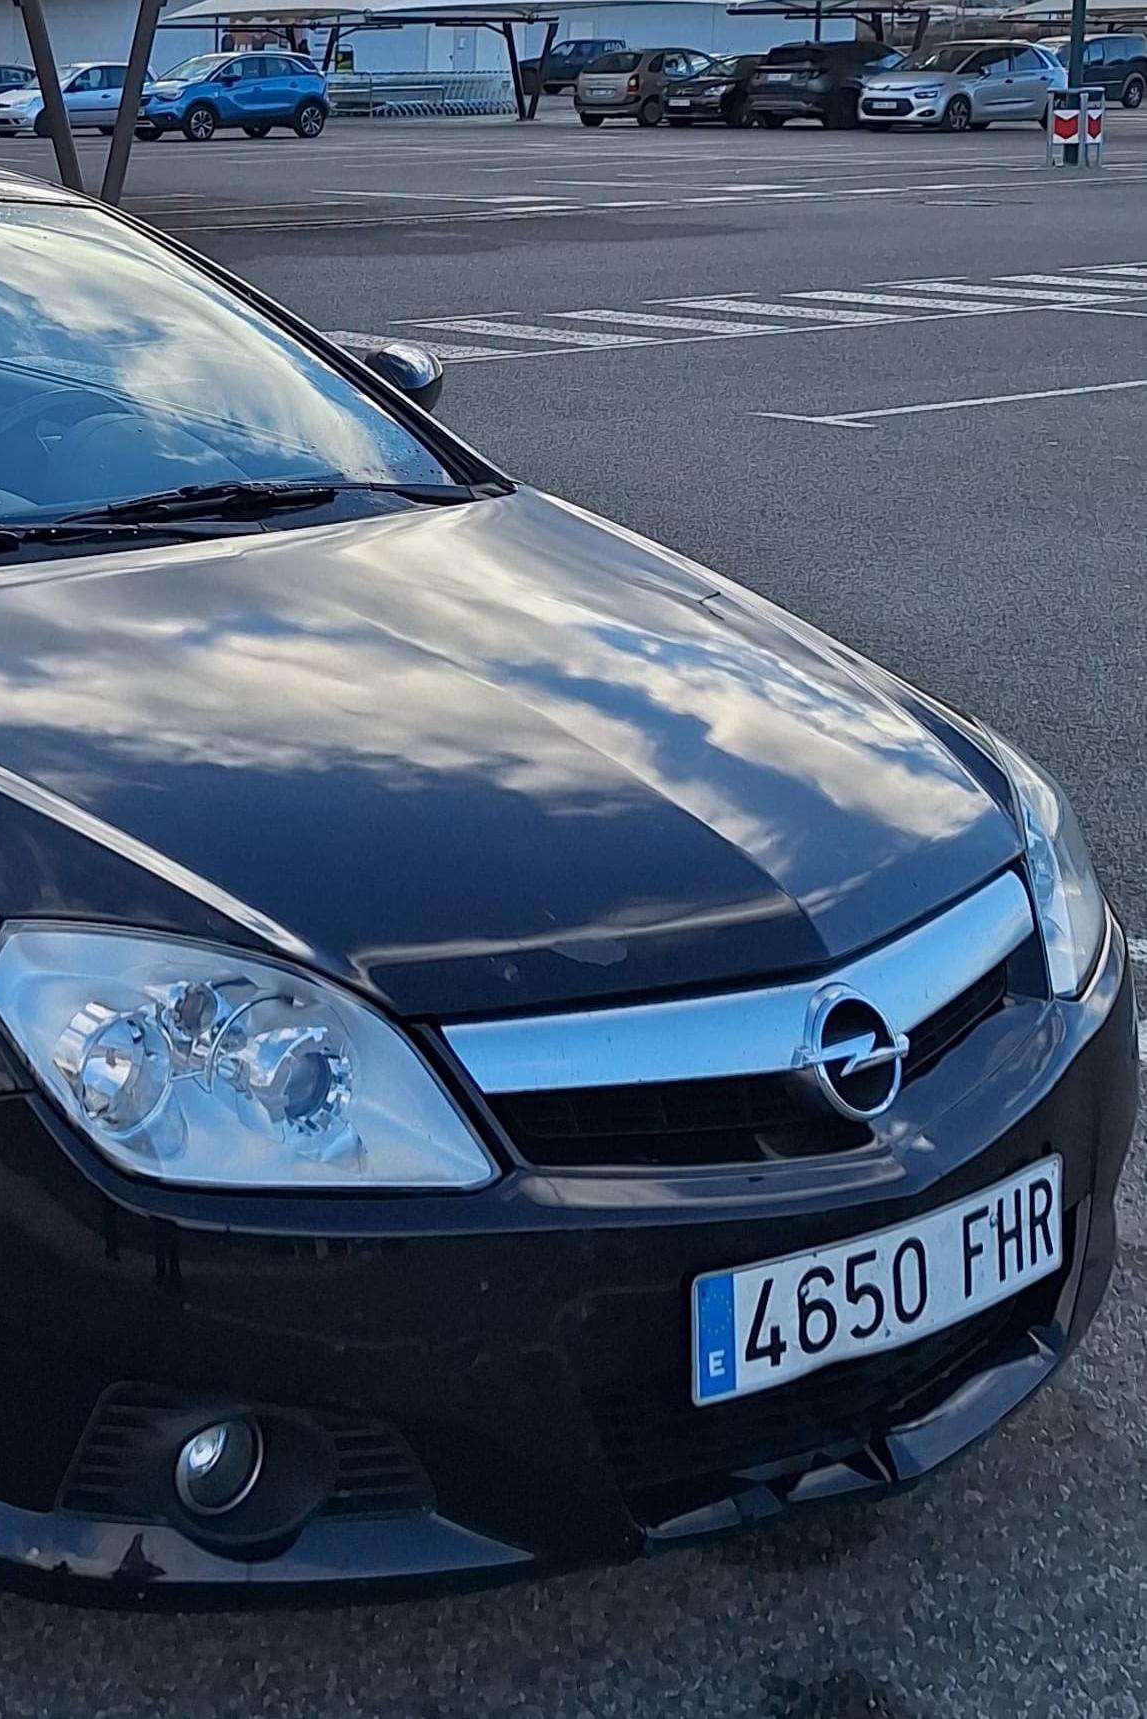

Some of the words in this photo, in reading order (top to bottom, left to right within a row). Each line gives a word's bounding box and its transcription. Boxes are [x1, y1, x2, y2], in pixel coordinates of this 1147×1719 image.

[744, 1237, 928, 1367] 4650
[962, 1177, 1055, 1300] FHR
[708, 1349, 726, 1378] E
